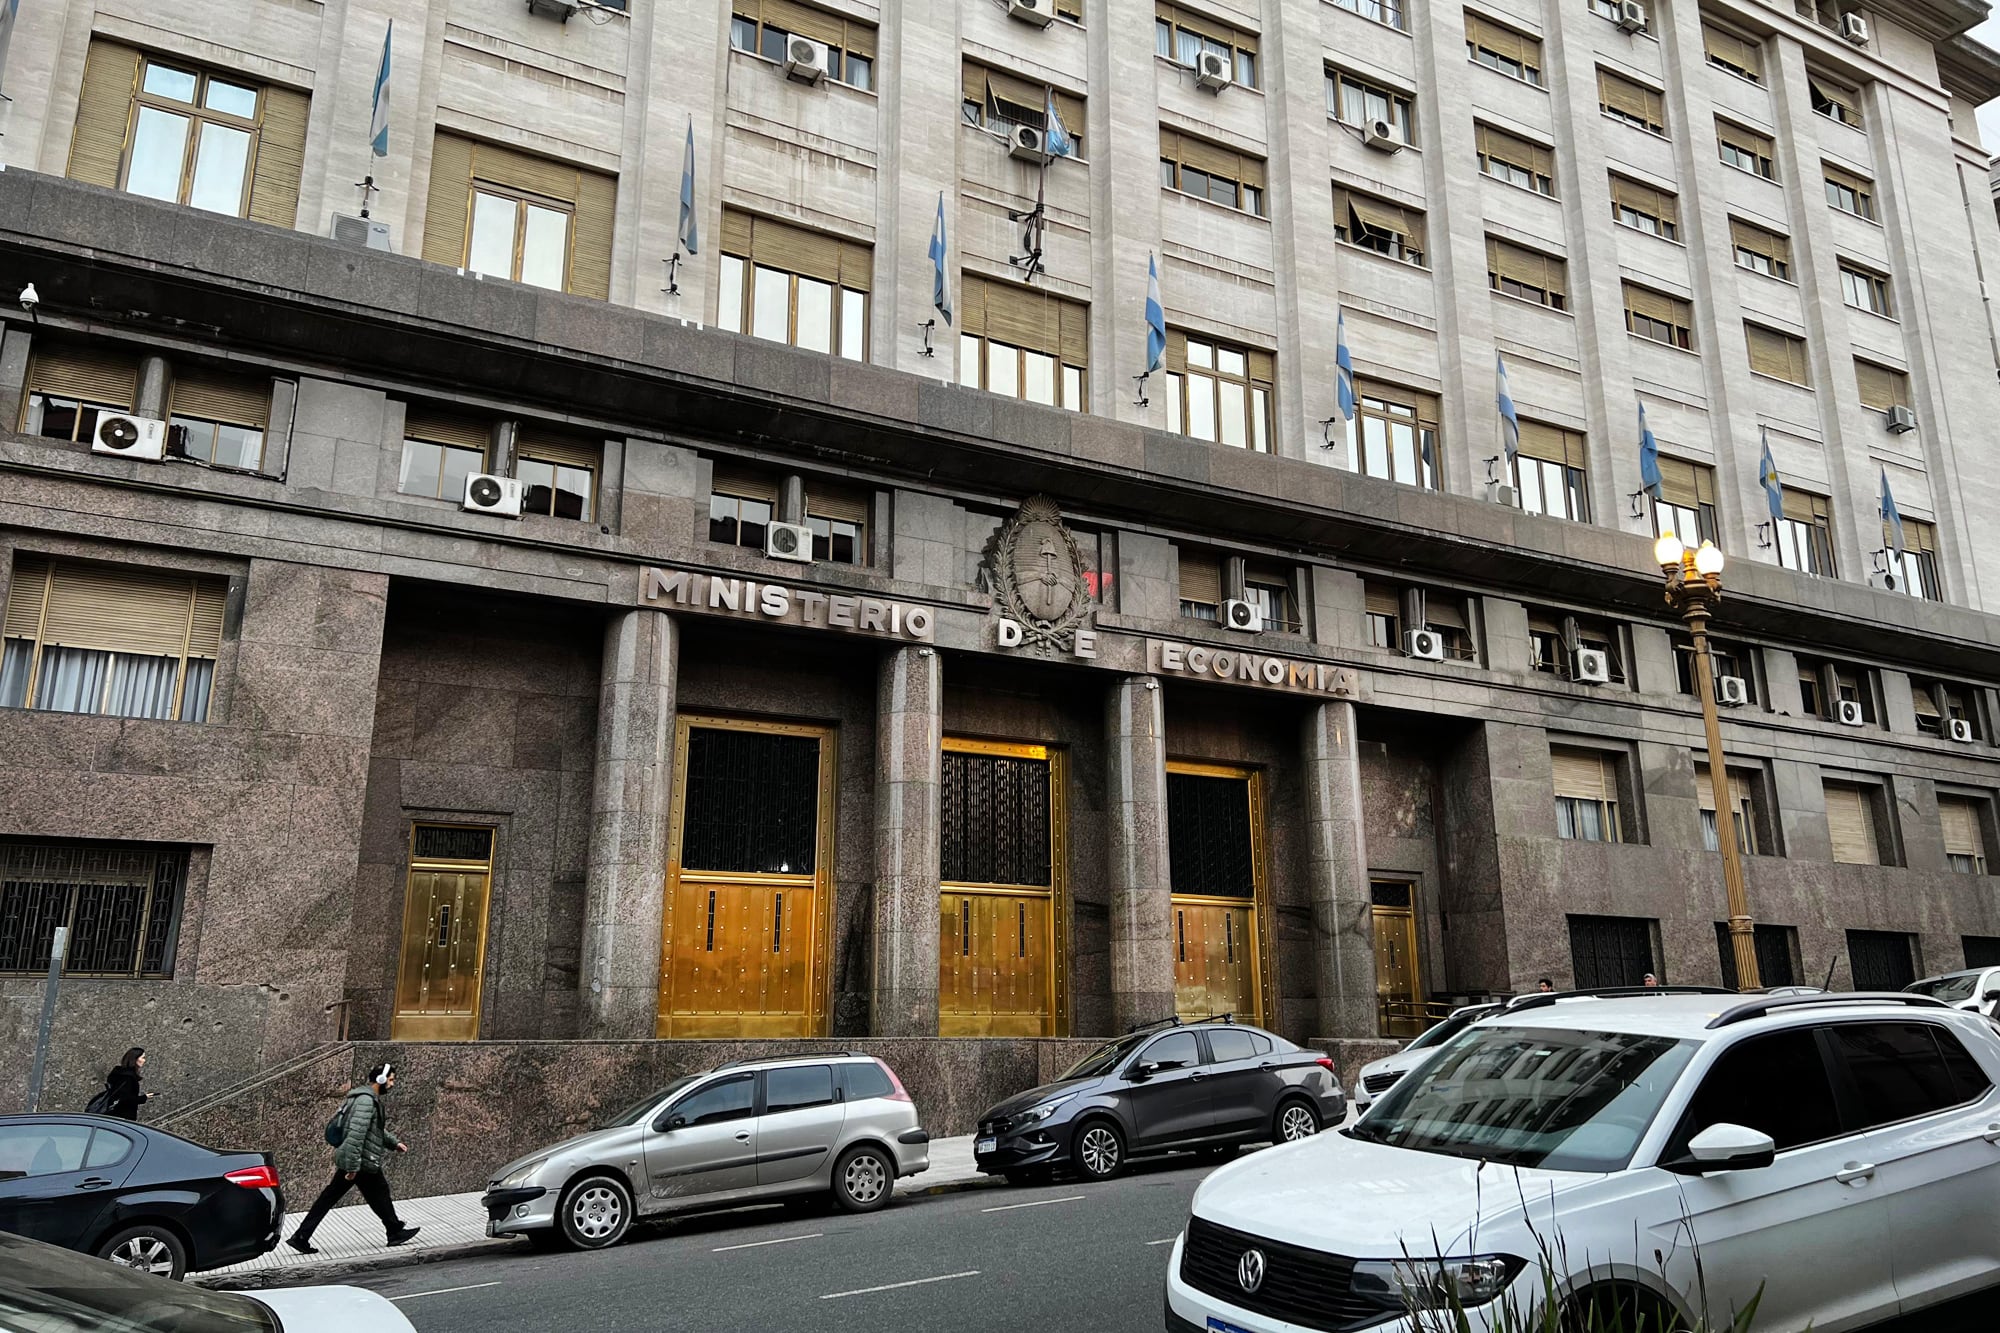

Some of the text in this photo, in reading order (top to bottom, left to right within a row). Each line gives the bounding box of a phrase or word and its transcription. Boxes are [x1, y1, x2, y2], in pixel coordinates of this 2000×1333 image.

[647, 567, 1352, 696] MINISTERIO DE ECONOMIA
